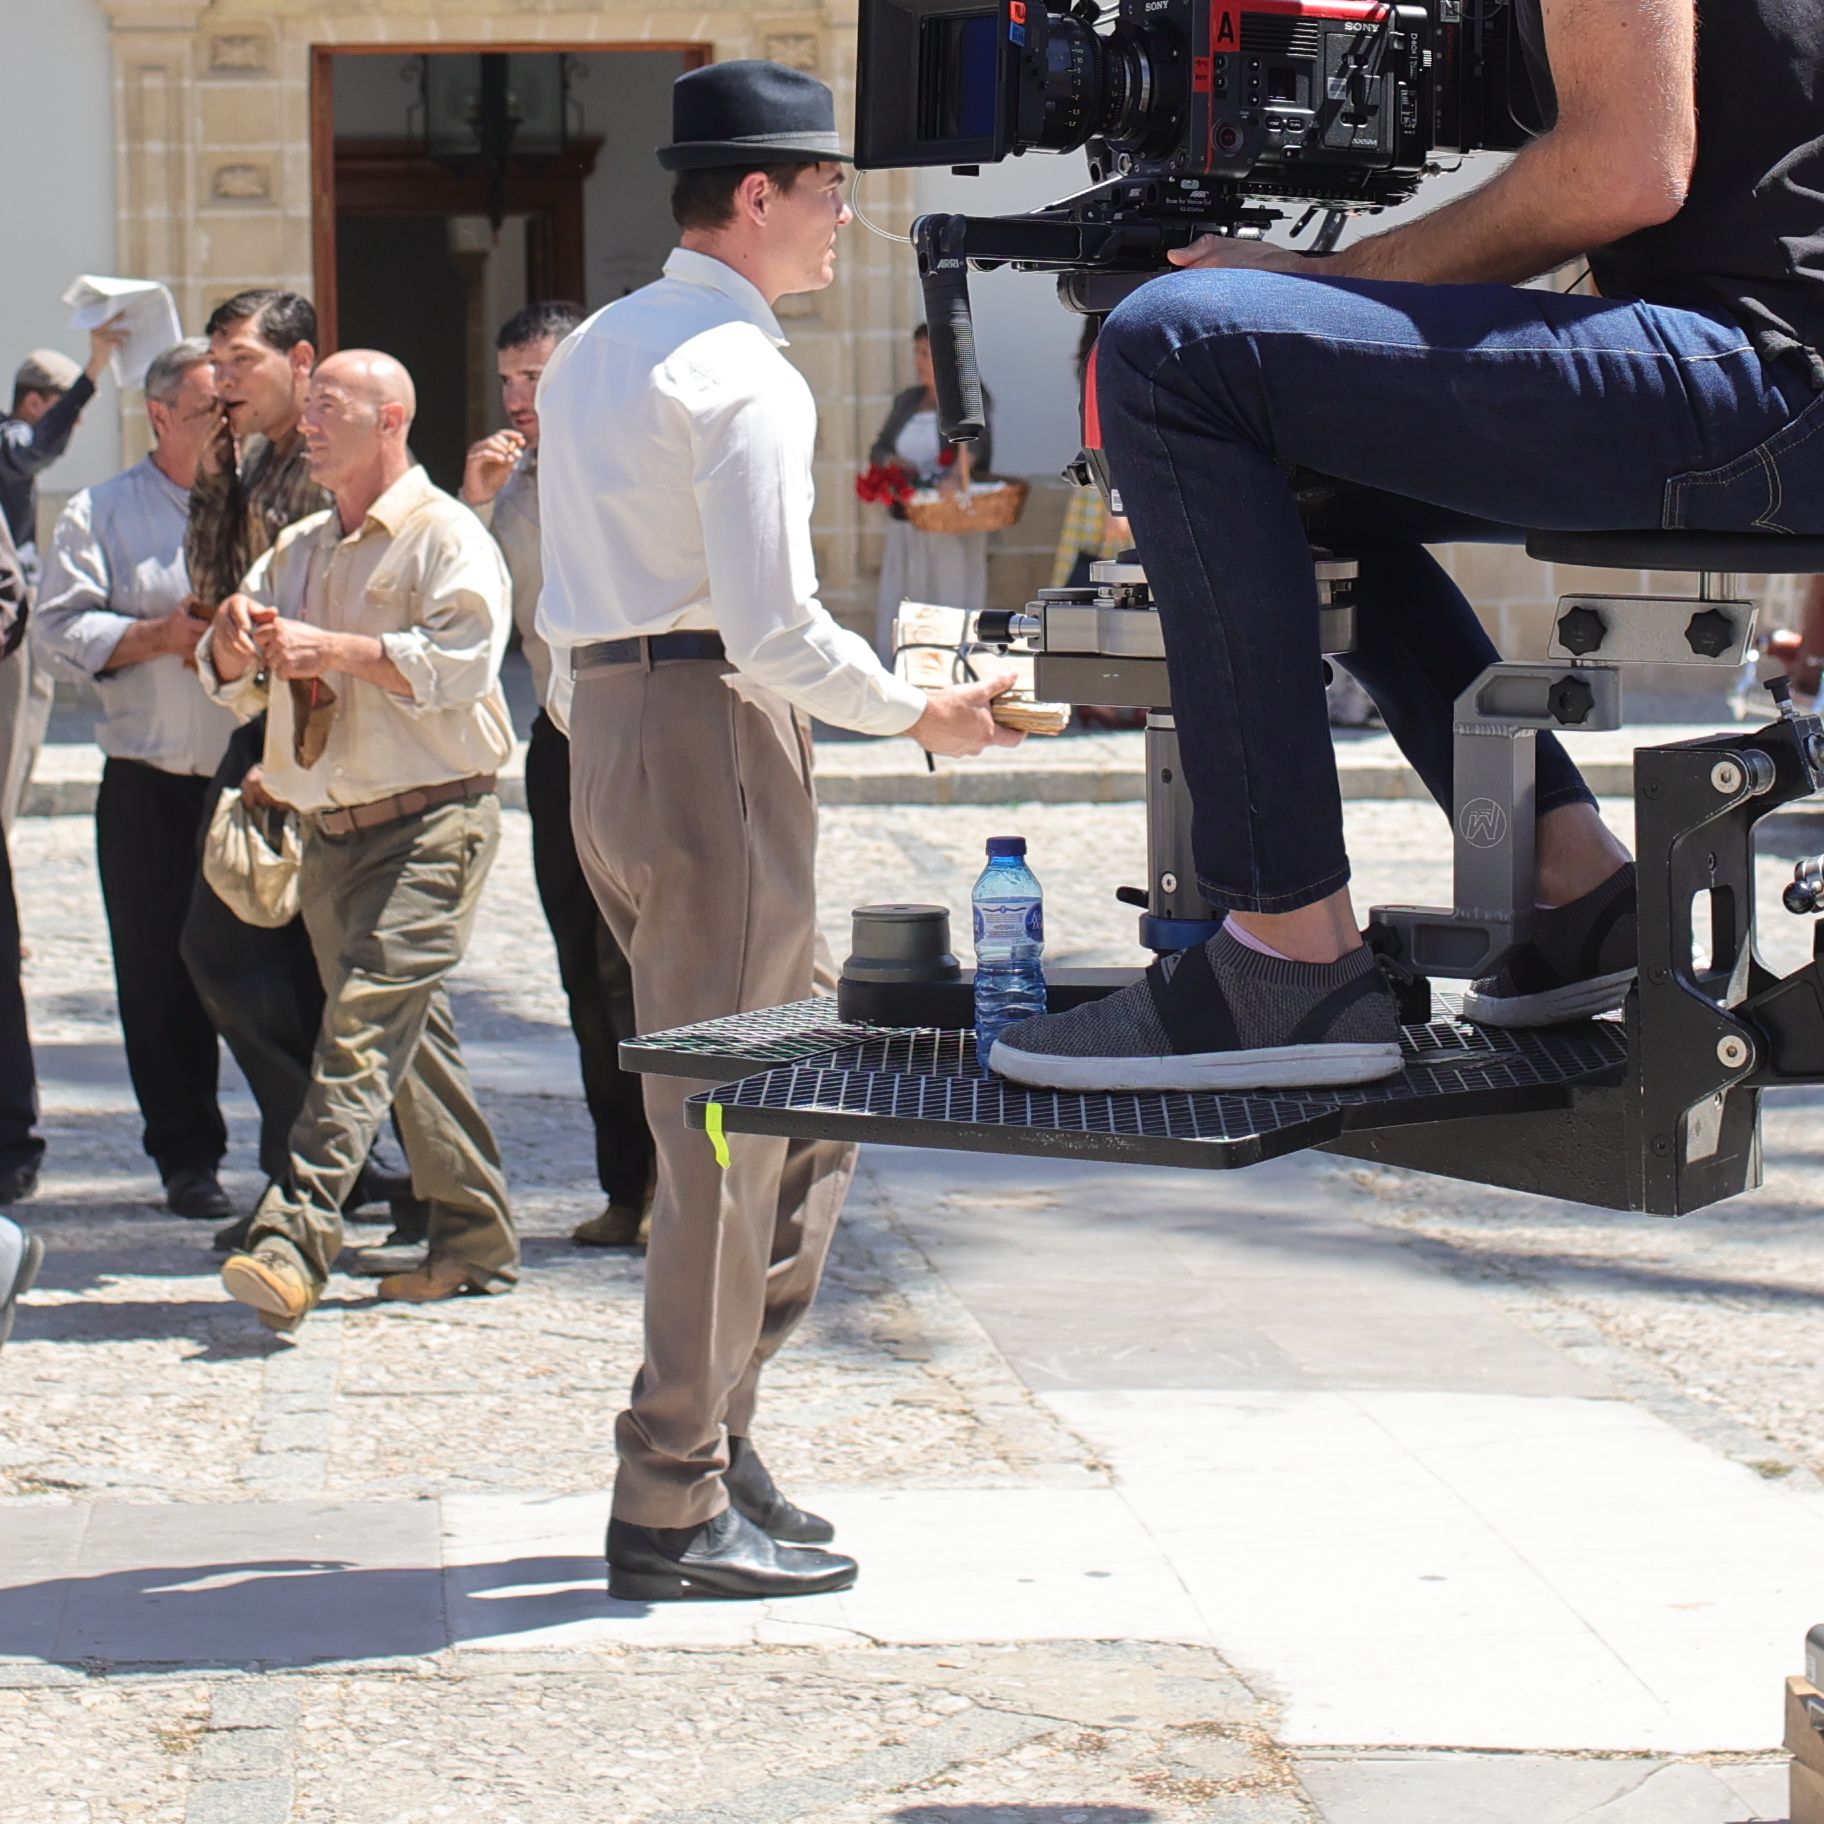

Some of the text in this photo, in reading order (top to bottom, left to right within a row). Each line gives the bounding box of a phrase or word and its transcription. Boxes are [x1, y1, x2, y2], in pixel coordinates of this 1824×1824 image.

[1145, 0, 1169, 12] SONY
[1216, 10, 1235, 44] A
[1344, 21, 1380, 33] SONY
[936, 258, 961, 269] ARRI
